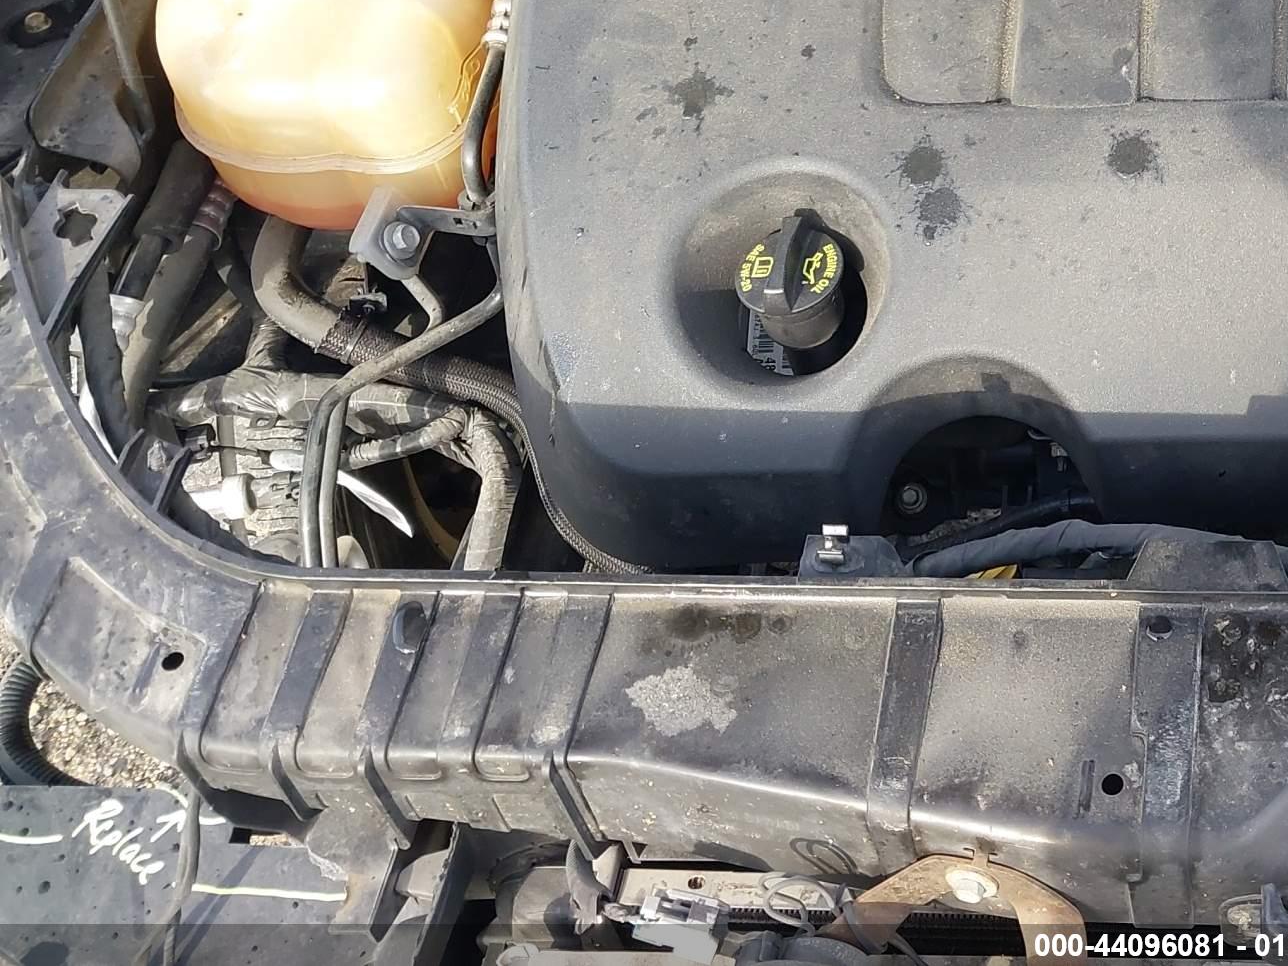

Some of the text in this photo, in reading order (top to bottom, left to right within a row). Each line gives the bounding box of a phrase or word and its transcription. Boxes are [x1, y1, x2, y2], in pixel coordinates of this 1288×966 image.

[740, 243, 765, 292] SAE 5W-20
[809, 244, 838, 294] ENGINE OIL
[71, 798, 166, 885] Replace
